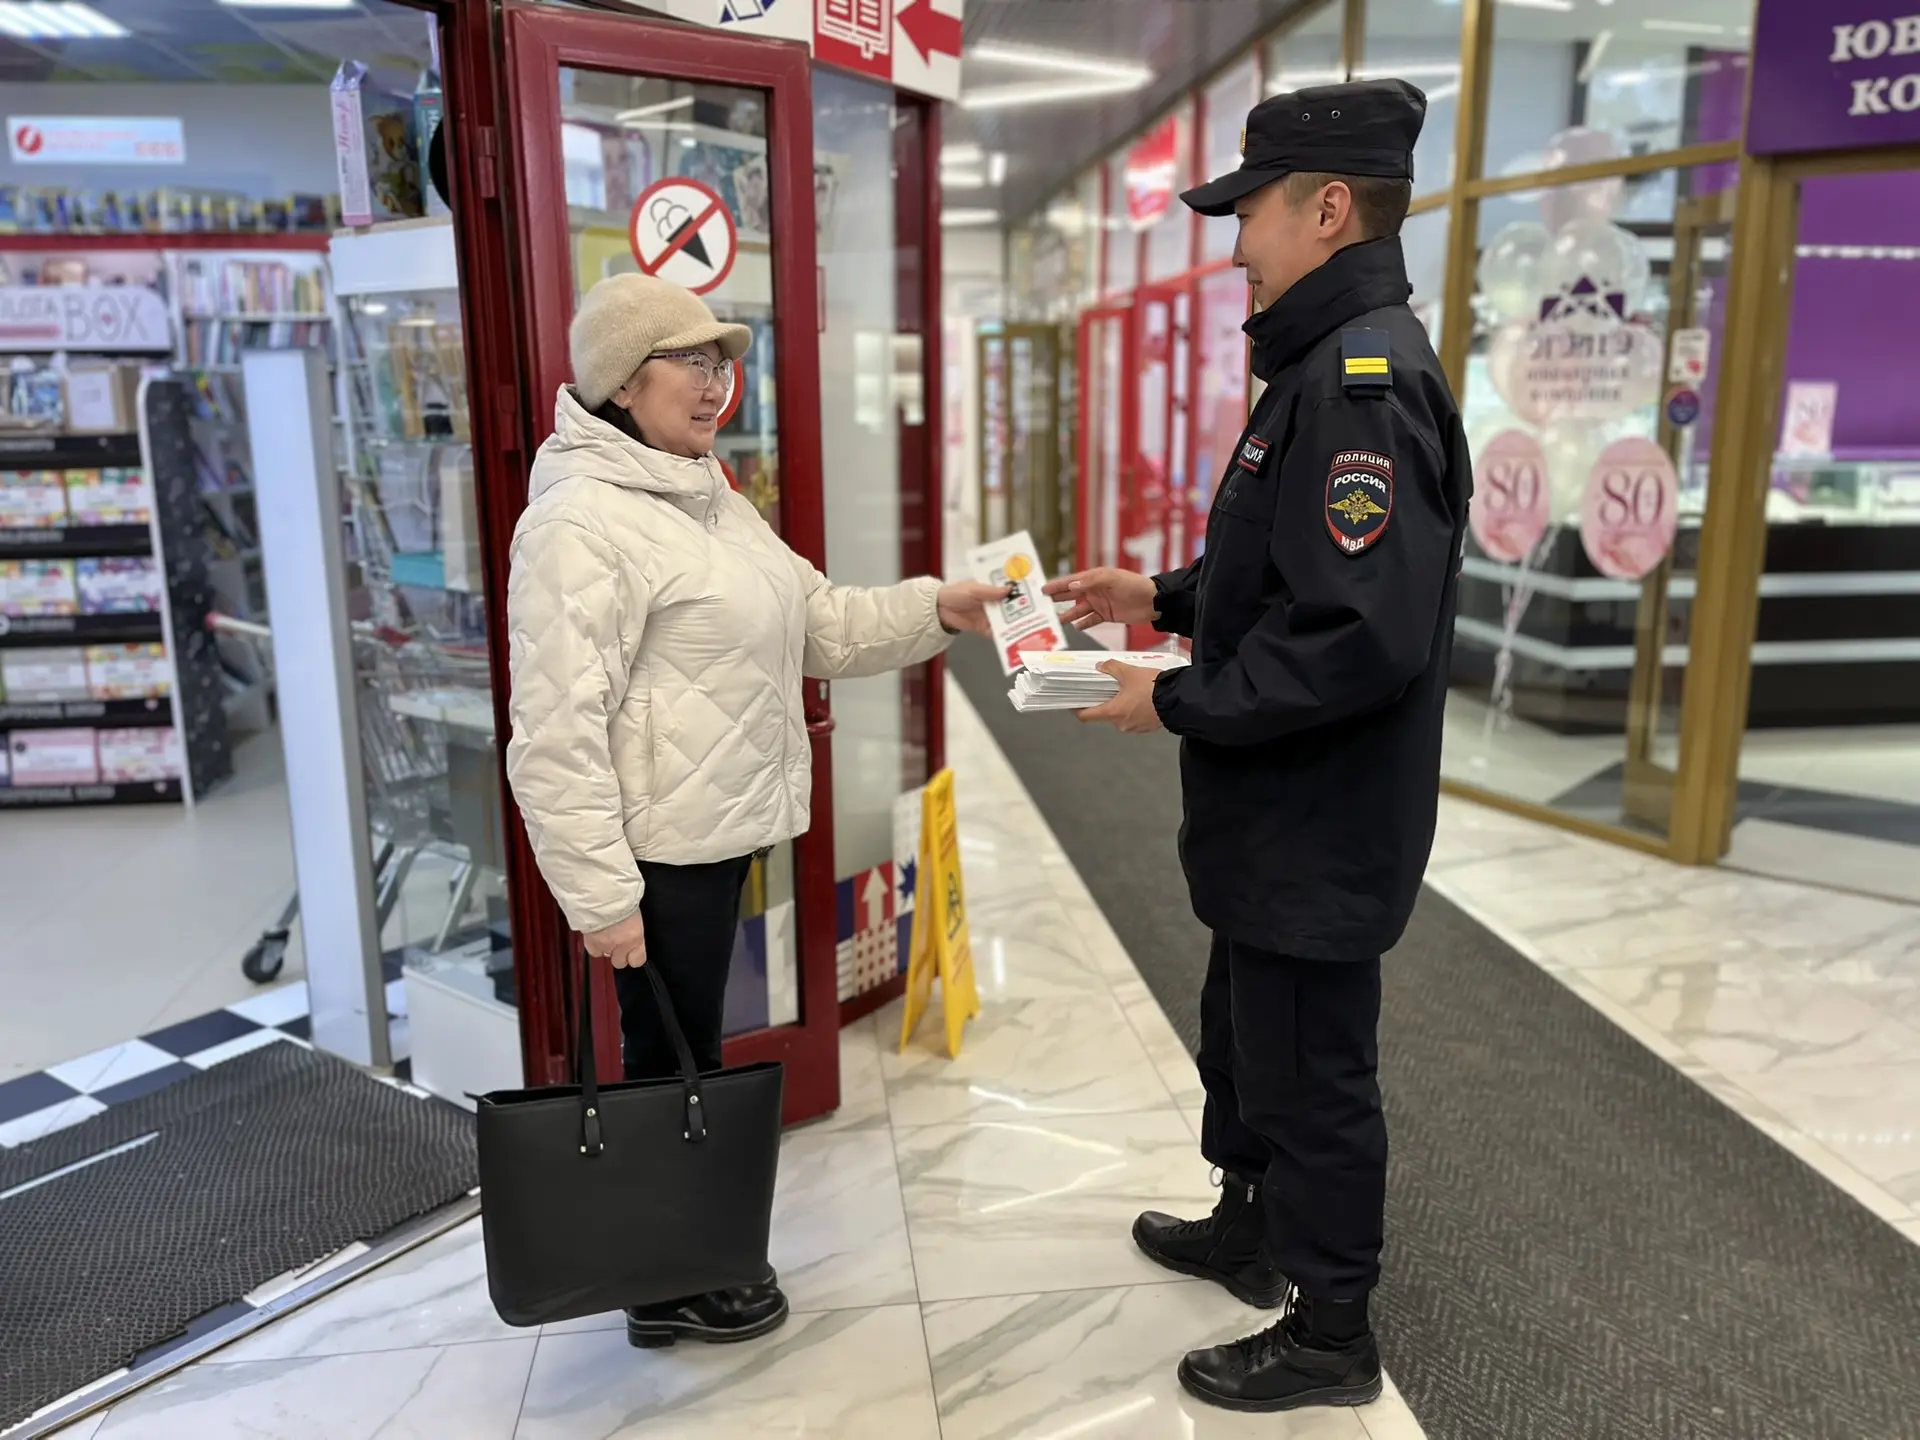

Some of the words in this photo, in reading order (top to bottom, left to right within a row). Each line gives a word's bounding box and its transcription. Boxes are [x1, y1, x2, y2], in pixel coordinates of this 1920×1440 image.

[1847, 73, 1920, 116] КО
[64, 293, 149, 342] BOX
[1333, 472, 1387, 493] РОССИЯ
[1335, 453, 1390, 469] ПОЛИЦИЯ
[1483, 463, 1539, 513] 80
[1599, 468, 1665, 527] 80
[1341, 535, 1365, 551] МВД
